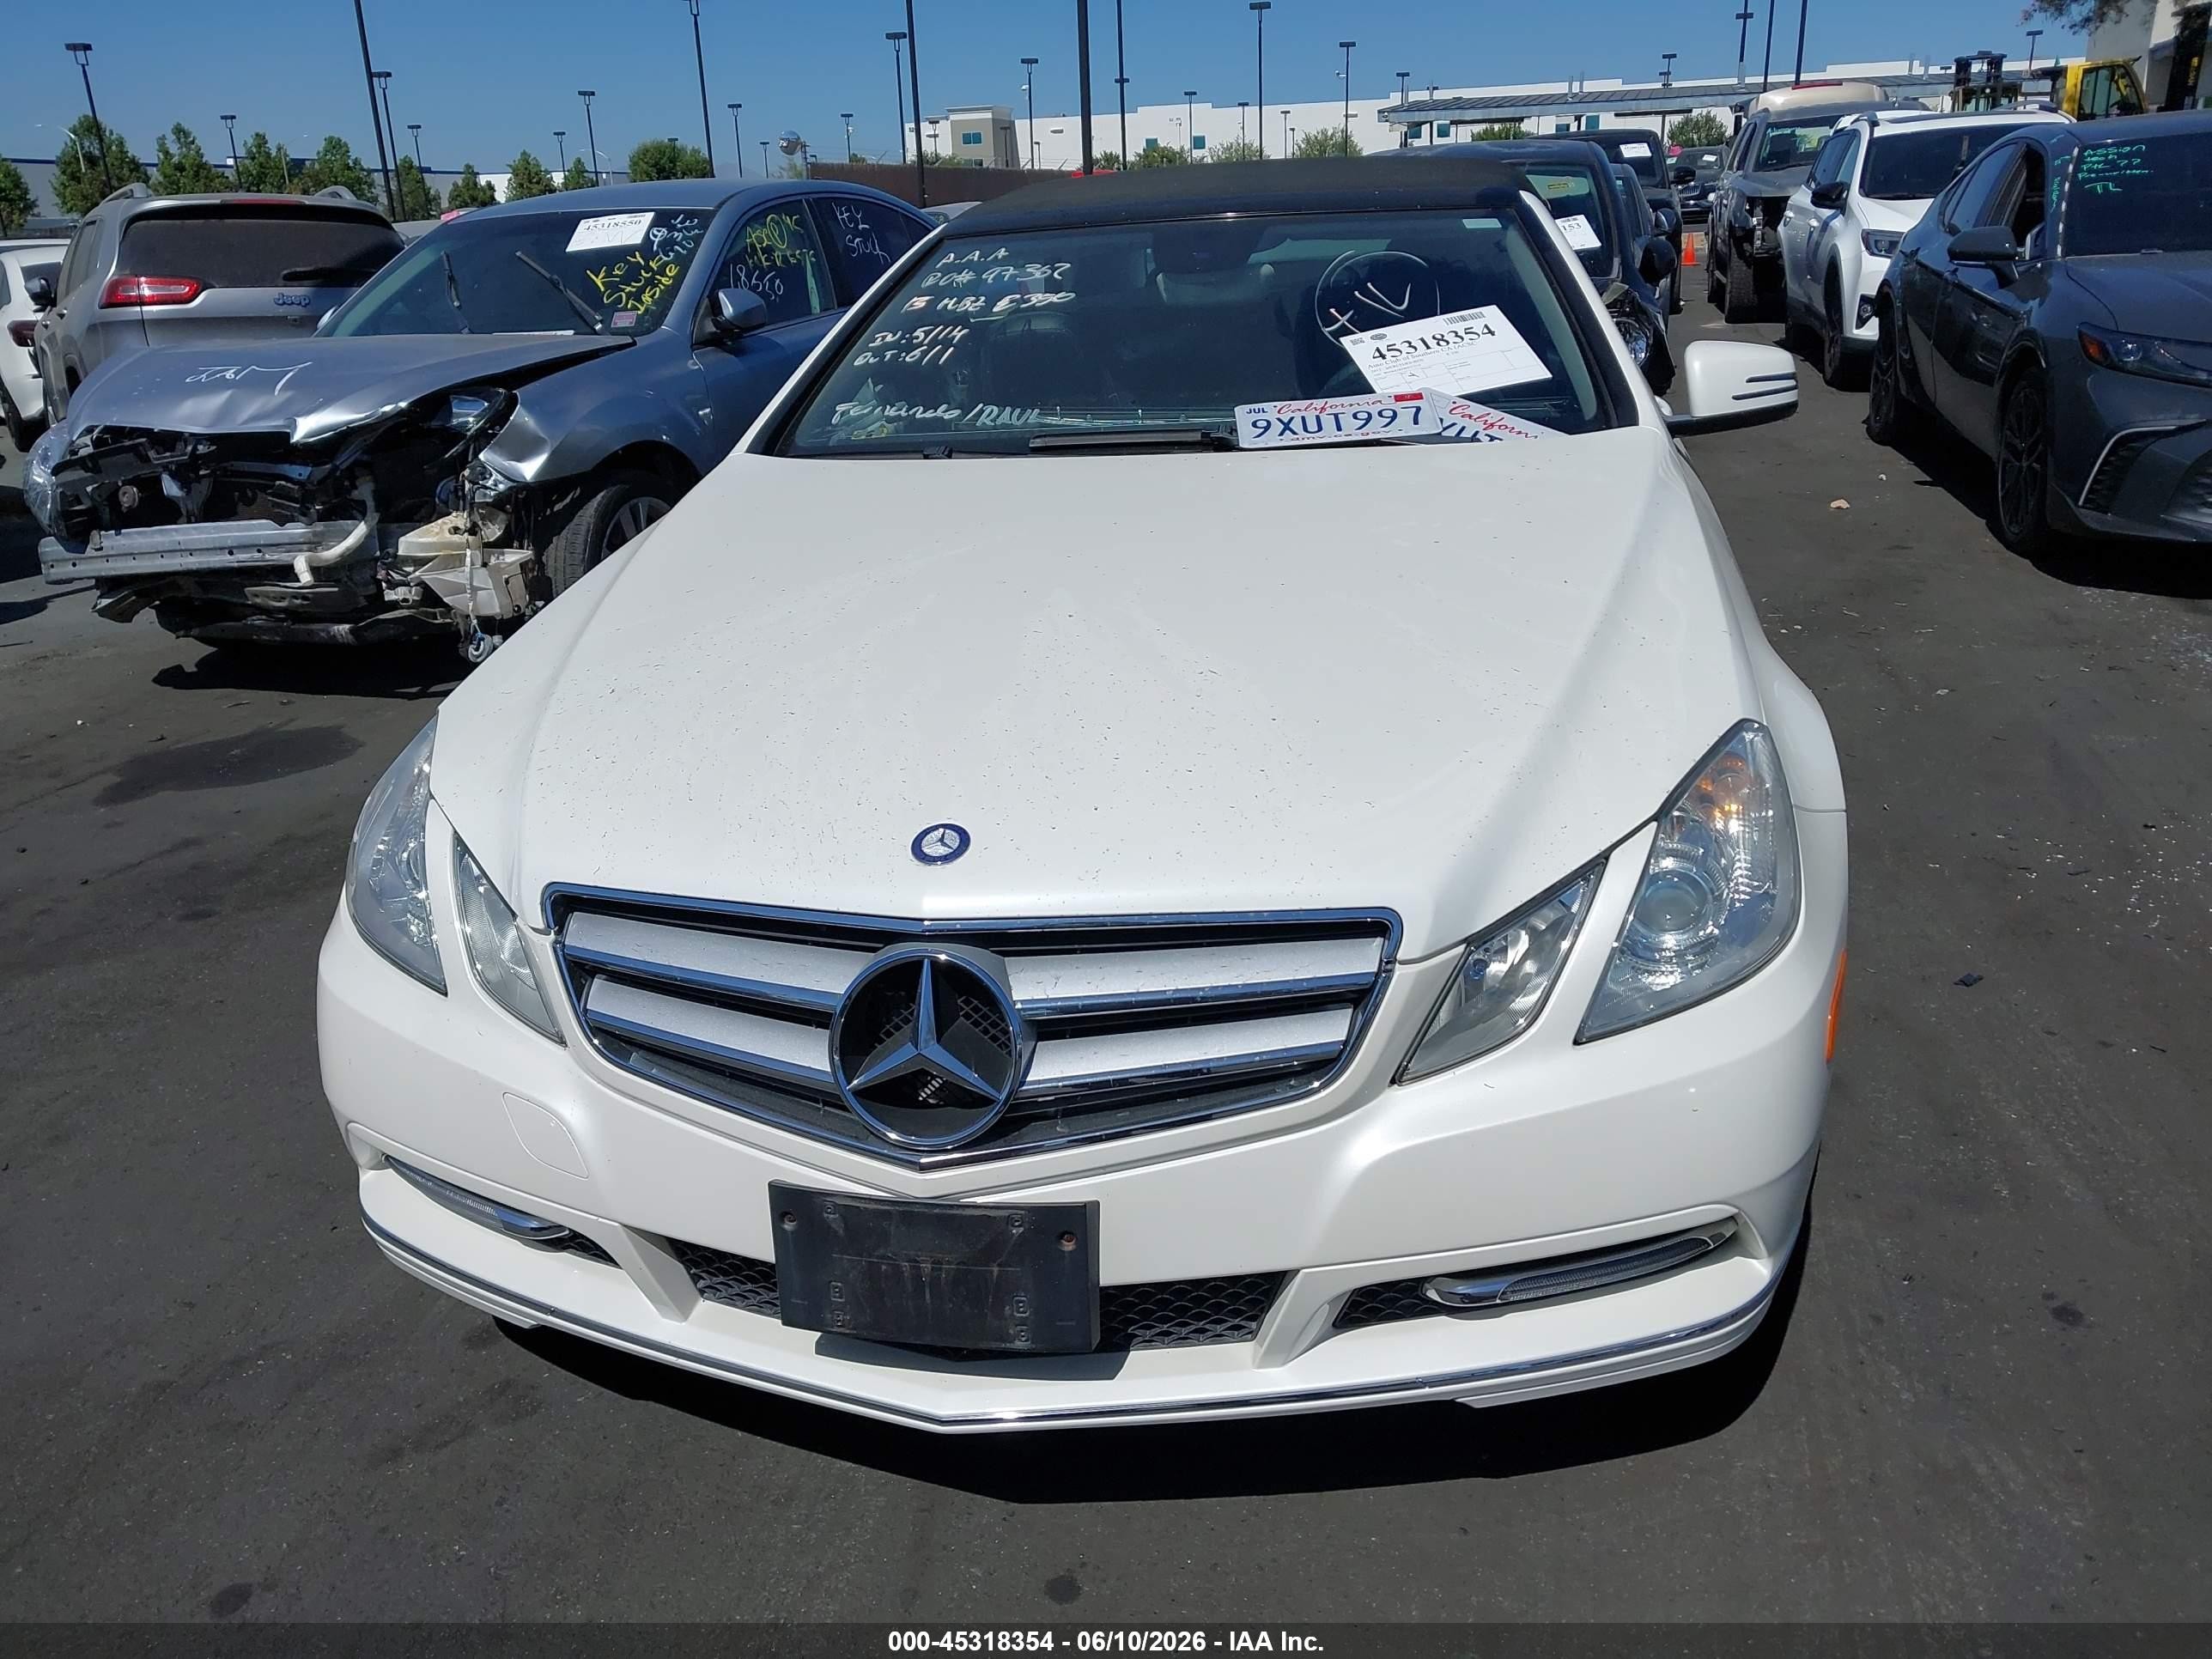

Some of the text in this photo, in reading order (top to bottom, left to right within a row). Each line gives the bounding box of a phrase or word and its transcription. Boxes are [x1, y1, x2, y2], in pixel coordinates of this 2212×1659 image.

[273, 293, 311, 307] Jeep
[1371, 323, 1496, 362] 45318354
[1277, 397, 1395, 416] California
[1250, 405, 1422, 440] 9XUT997
